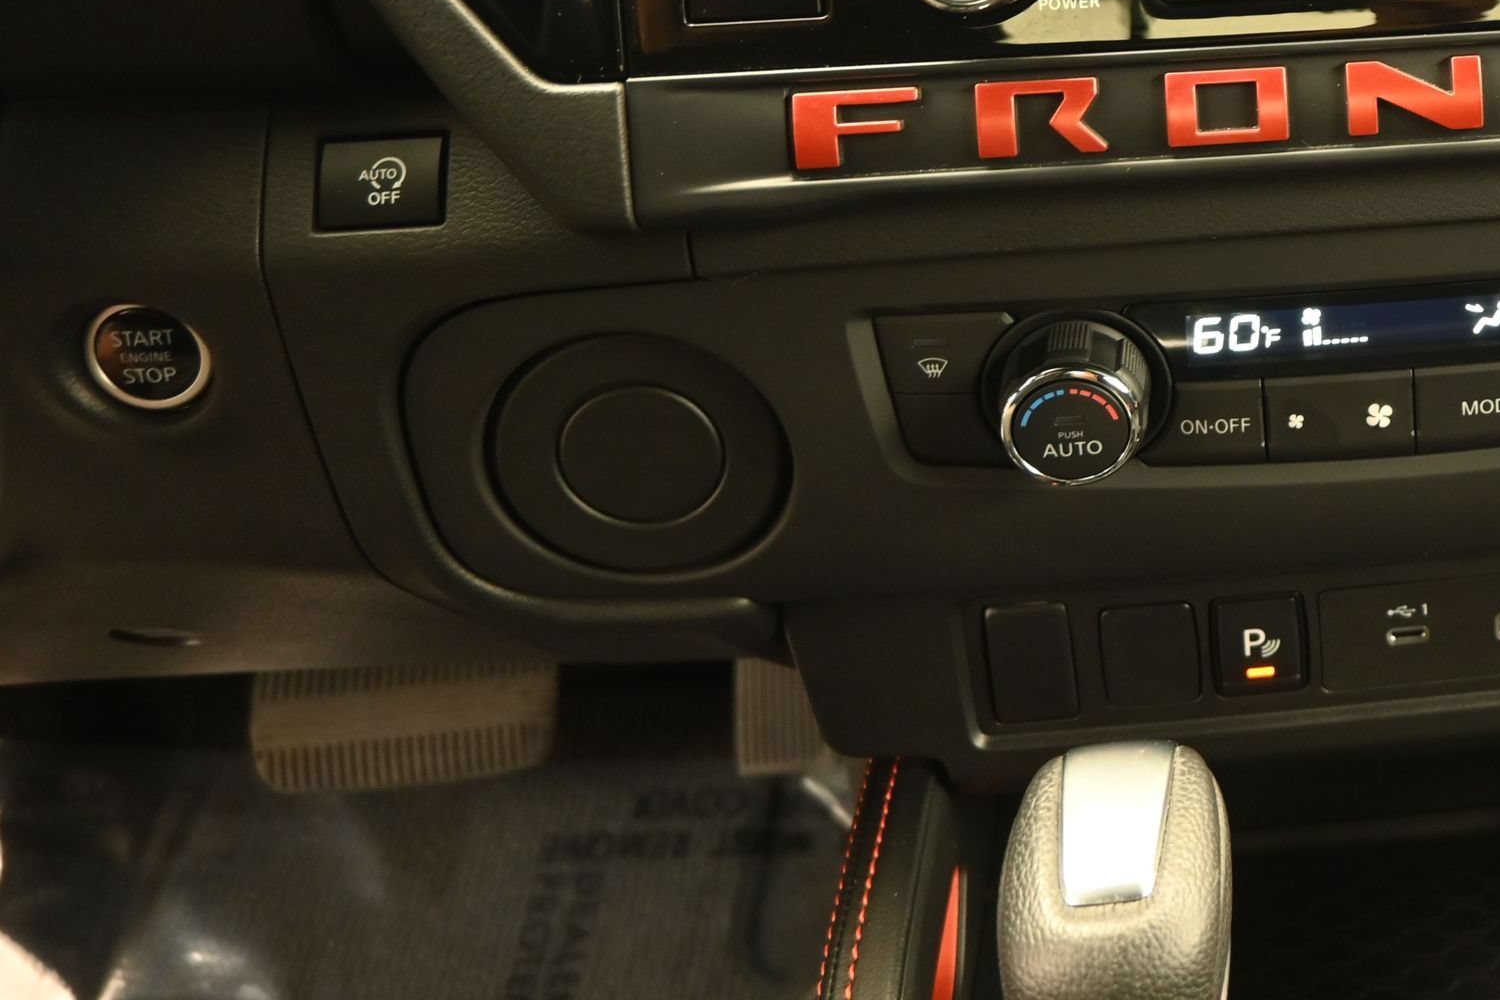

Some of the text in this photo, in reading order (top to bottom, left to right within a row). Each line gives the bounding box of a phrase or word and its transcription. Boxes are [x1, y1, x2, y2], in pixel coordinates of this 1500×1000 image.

[358, 167, 398, 182] AUTO
[367, 190, 401, 206] OFF
[110, 328, 174, 348] START
[119, 350, 173, 364] ENGINE
[122, 367, 177, 384] STOP
[1057, 429, 1084, 439] PUSH
[1043, 440, 1103, 458] AUTO
